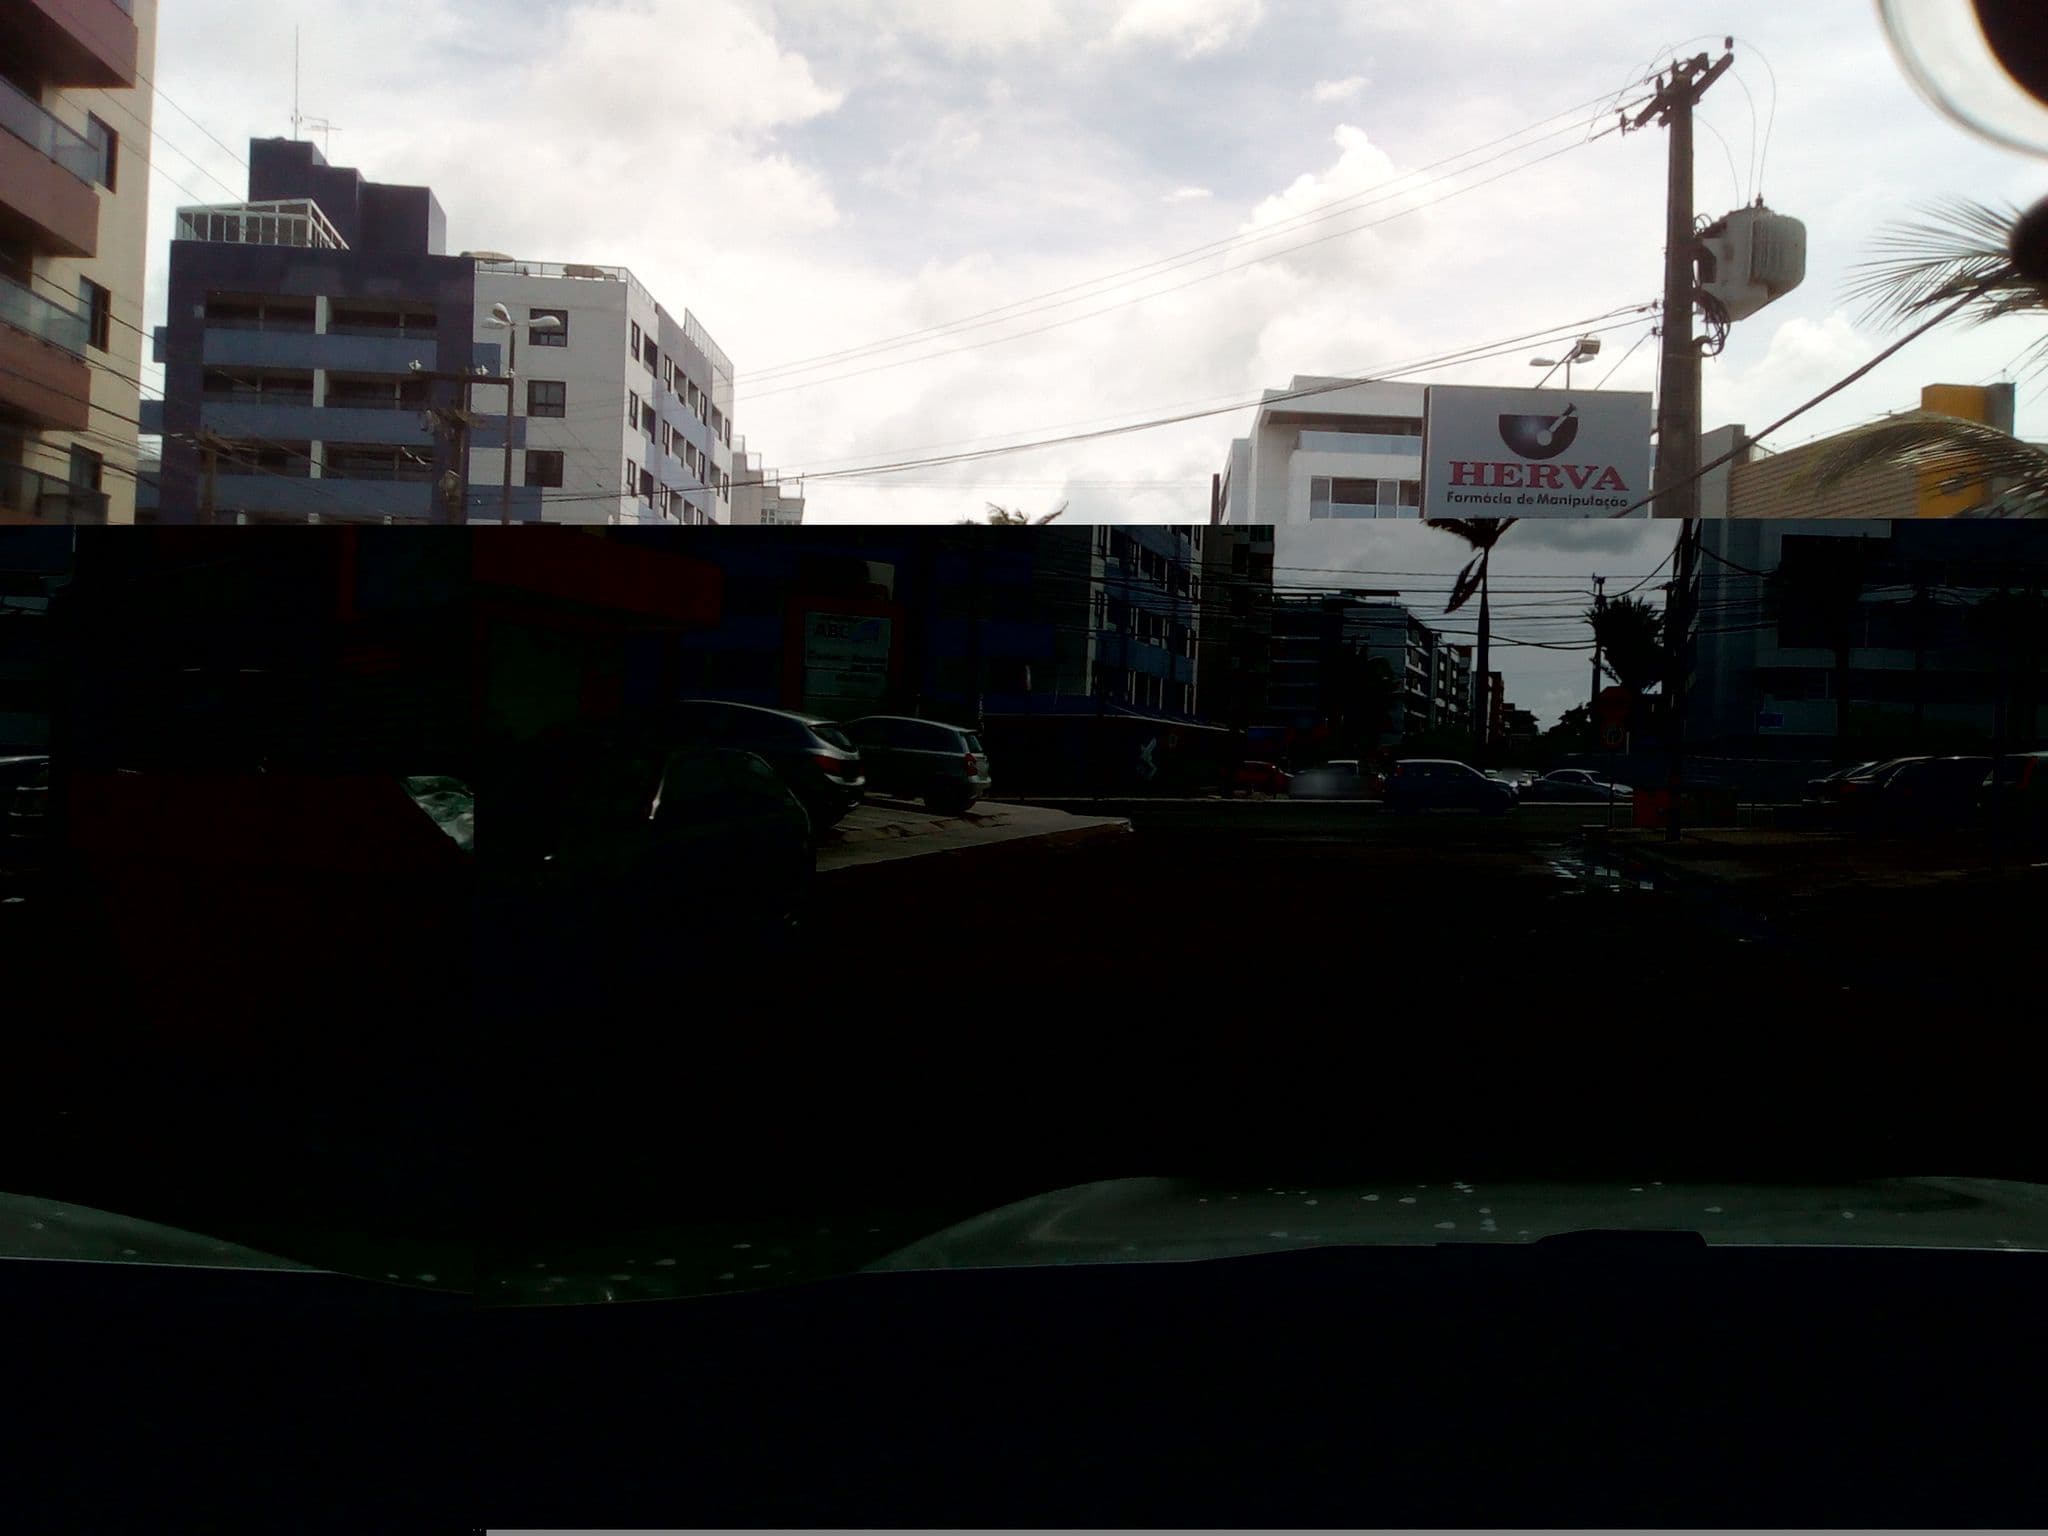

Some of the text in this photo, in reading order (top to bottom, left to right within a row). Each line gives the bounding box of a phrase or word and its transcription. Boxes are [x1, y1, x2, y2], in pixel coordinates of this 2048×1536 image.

[1448, 461, 1630, 491] HERVA
[1446, 491, 1628, 510] Farmácia de Manipulação
